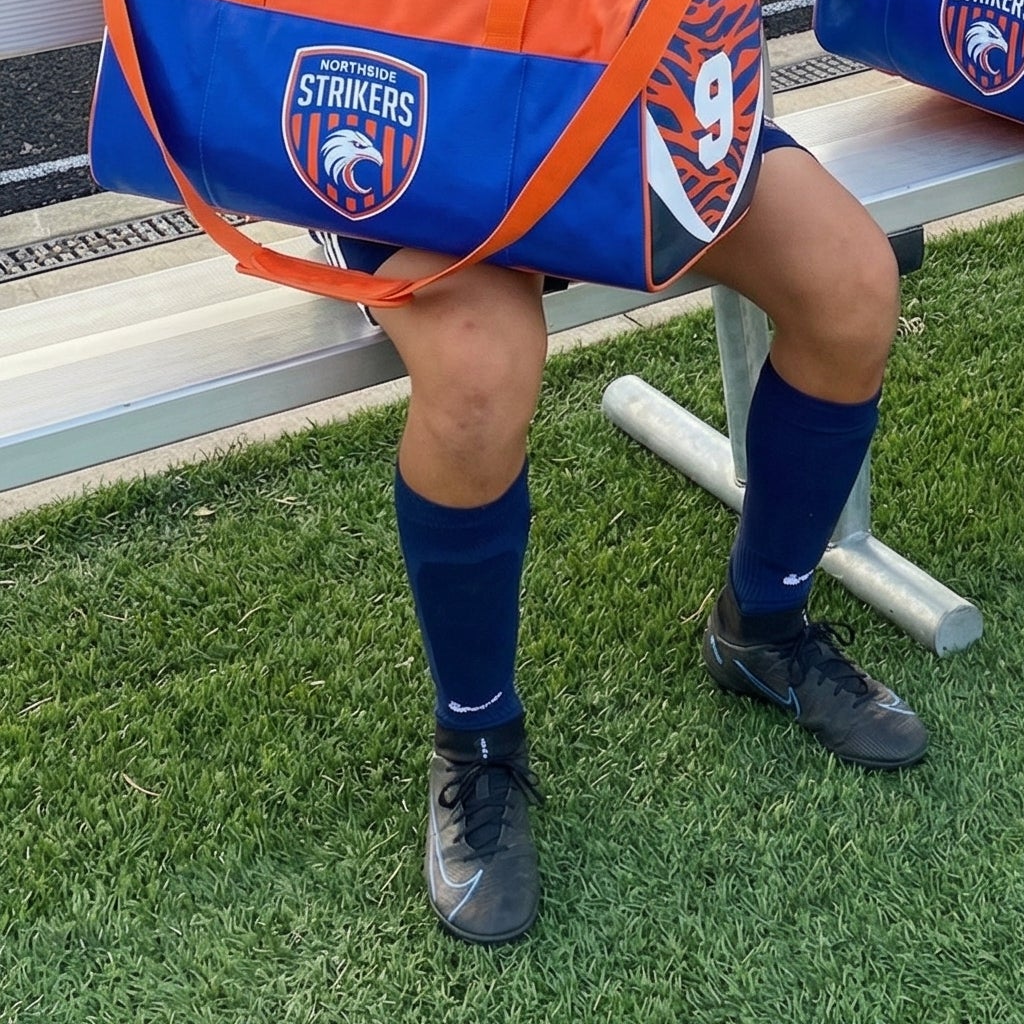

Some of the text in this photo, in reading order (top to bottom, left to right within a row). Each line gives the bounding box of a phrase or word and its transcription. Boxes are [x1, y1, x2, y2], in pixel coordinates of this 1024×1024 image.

[320, 59, 397, 84] NORTHSIDE
[297, 73, 415, 128] STRIKERS
[694, 51, 734, 170] 9
